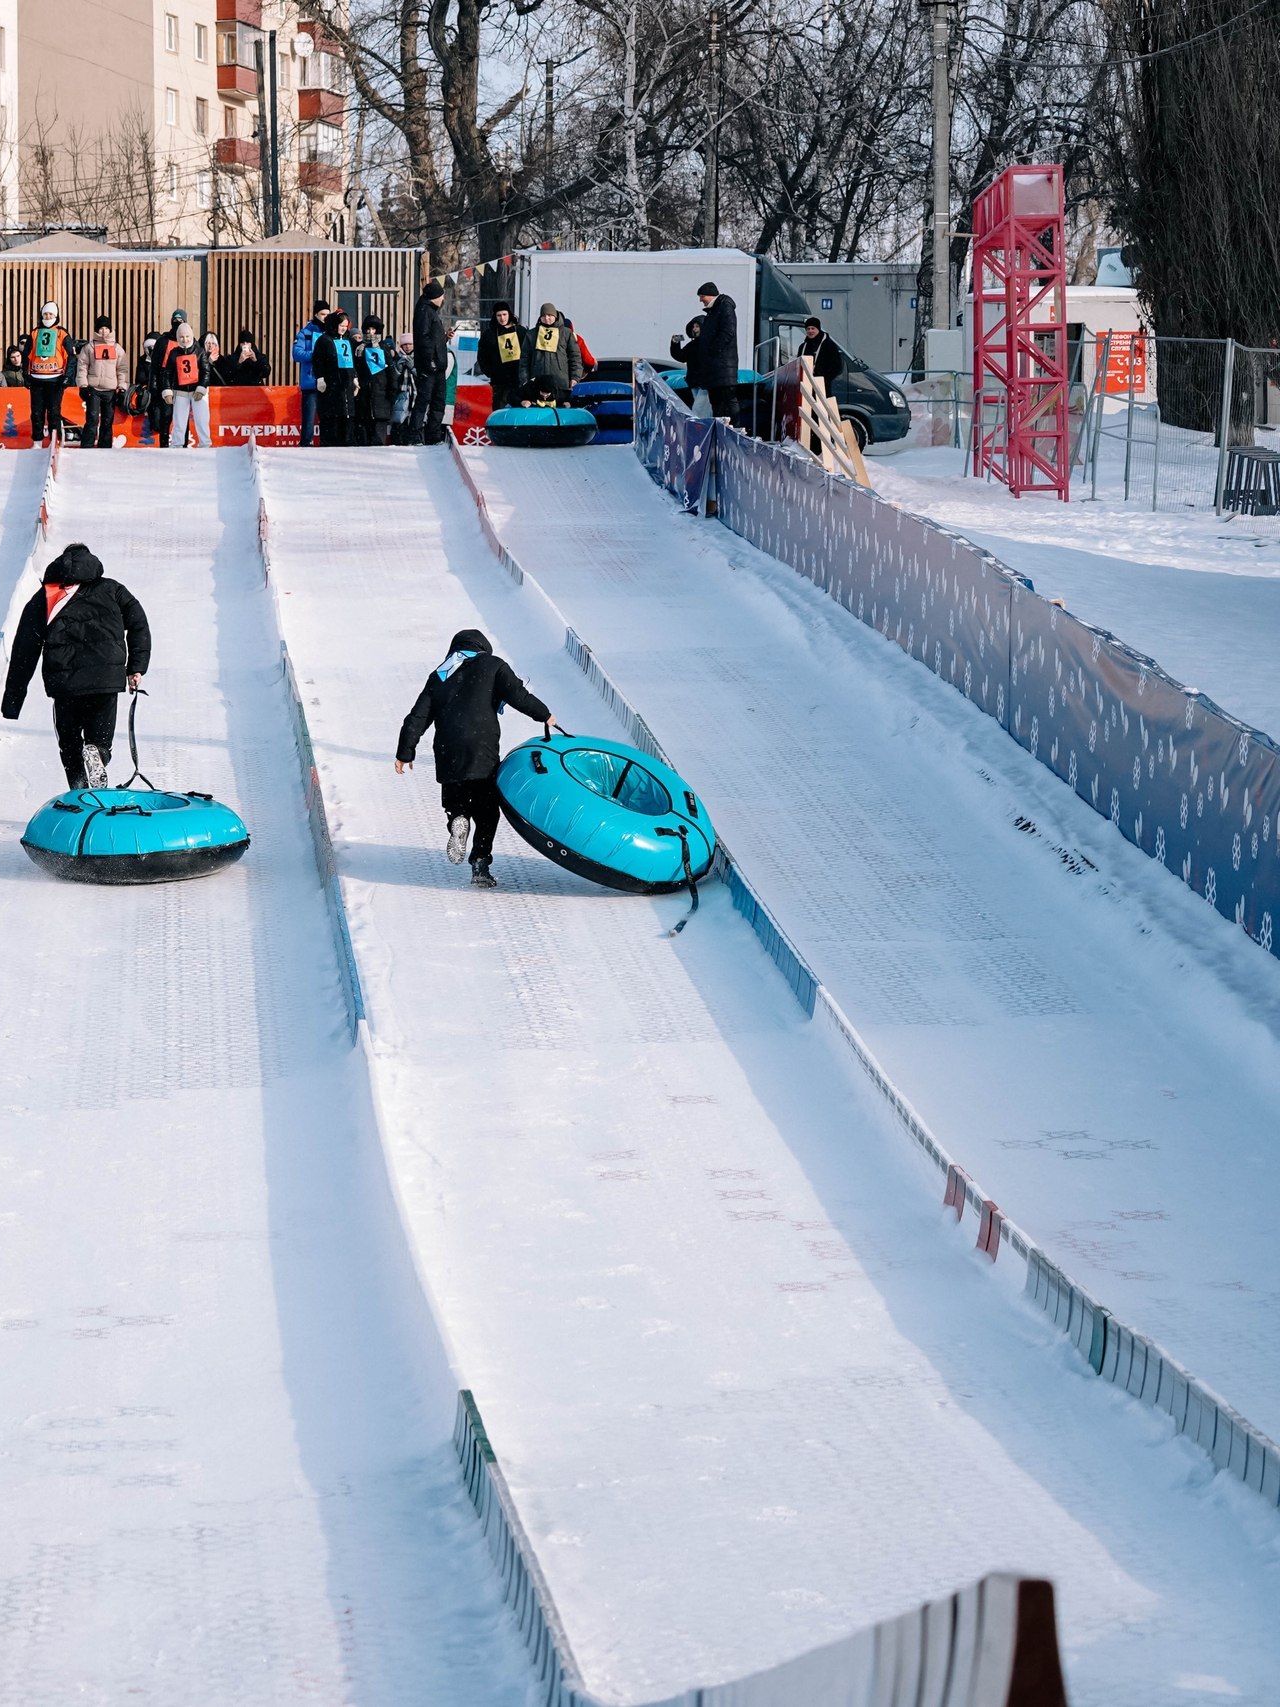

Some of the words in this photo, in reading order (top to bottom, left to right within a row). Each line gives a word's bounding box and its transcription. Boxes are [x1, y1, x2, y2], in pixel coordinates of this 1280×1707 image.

[41, 332, 51, 346] 3
[543, 329, 553, 341] 3
[341, 343, 350, 357] 2
[504, 338, 513, 351] 4
[101, 348, 110, 360] 4
[181, 359, 192, 374] 3
